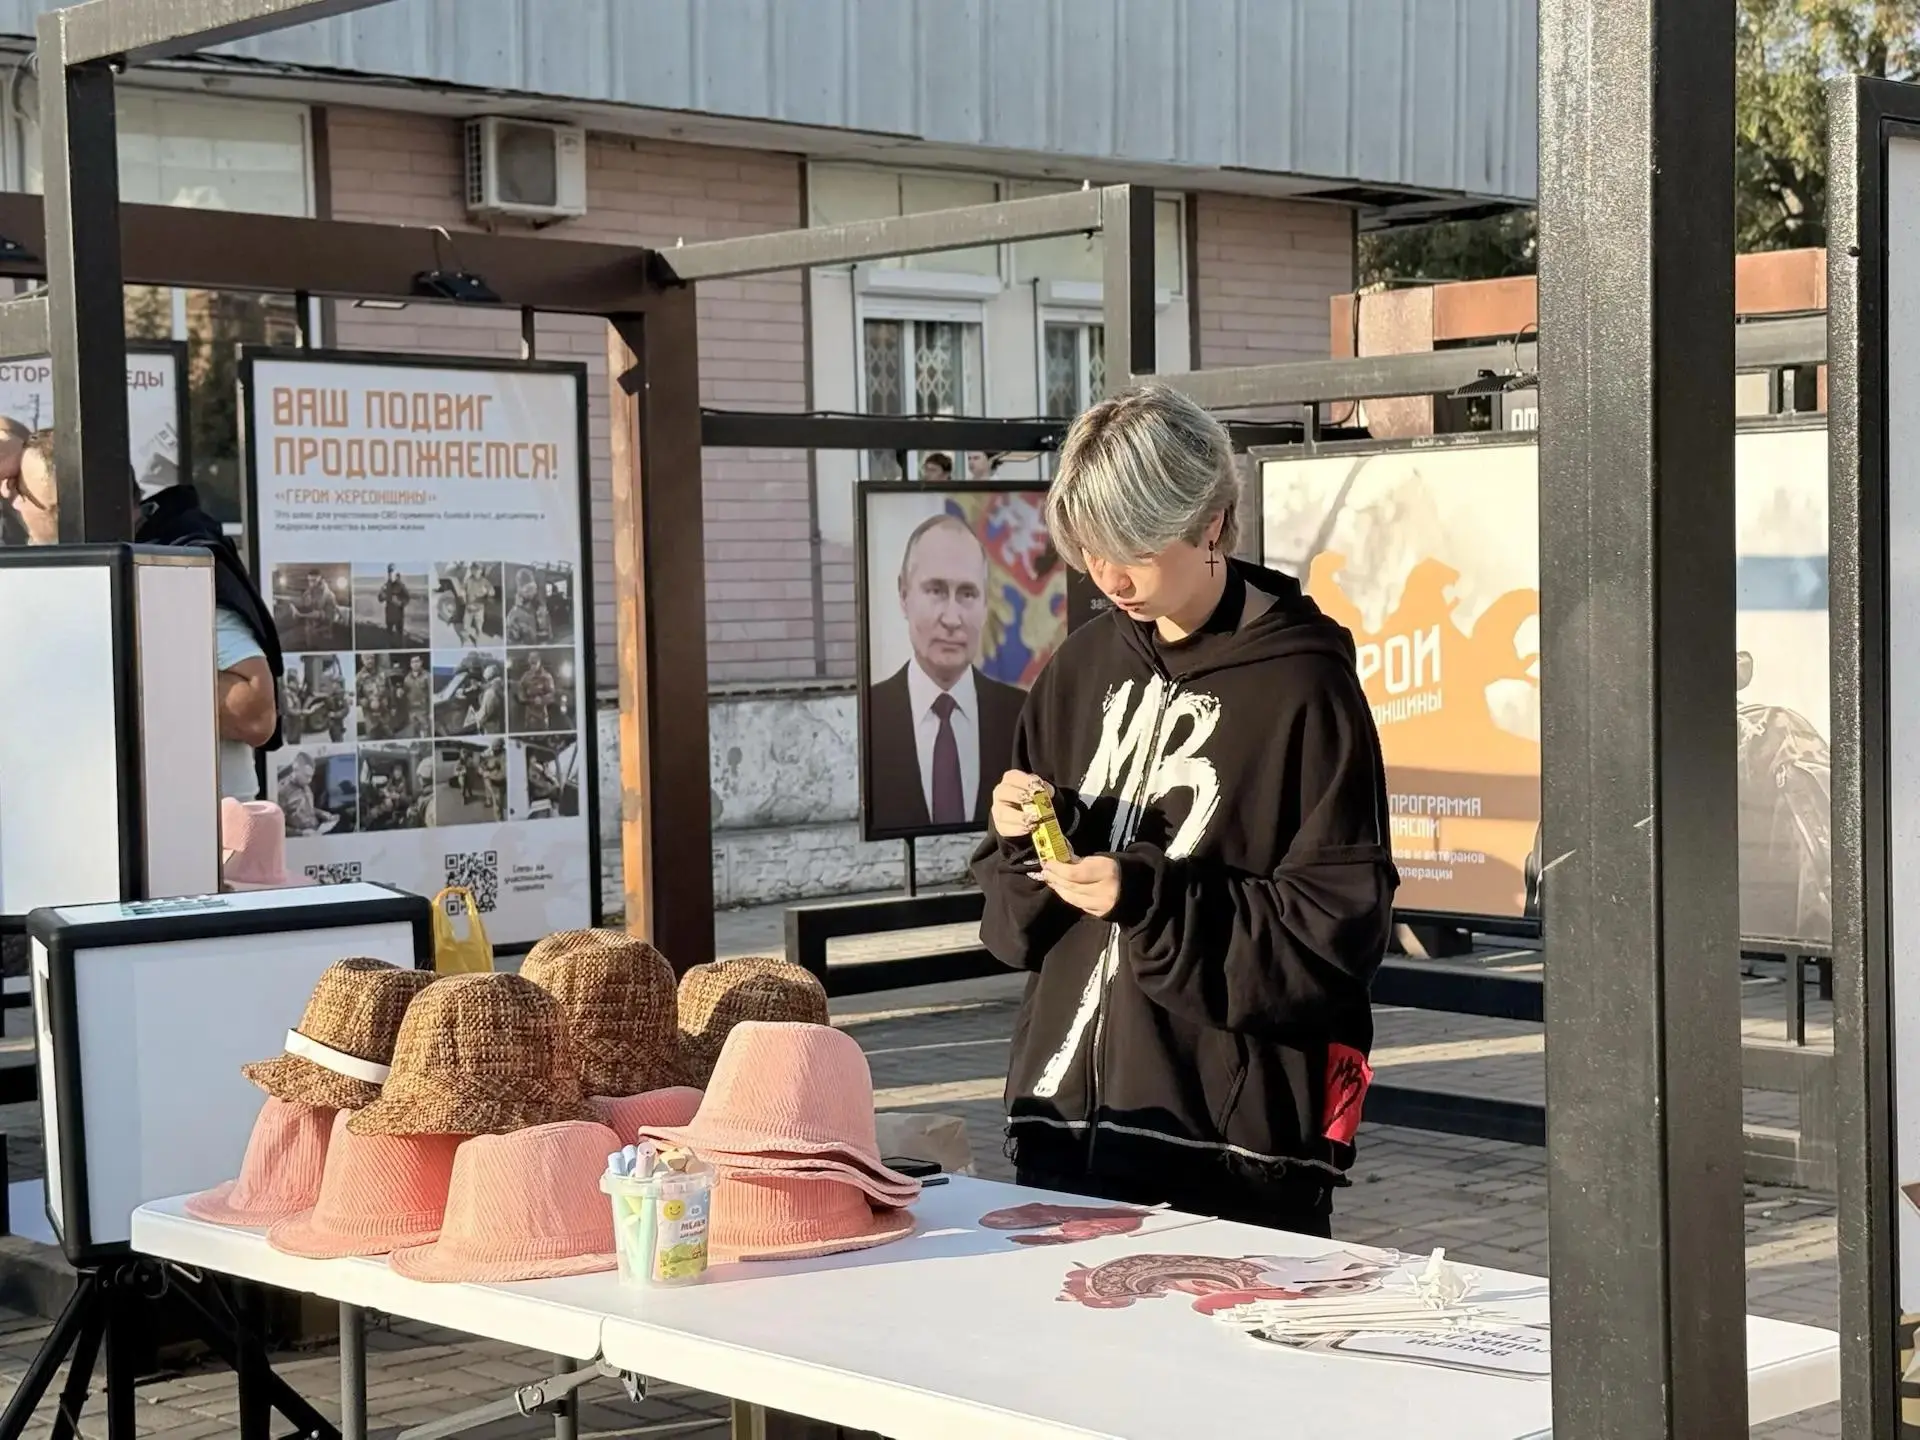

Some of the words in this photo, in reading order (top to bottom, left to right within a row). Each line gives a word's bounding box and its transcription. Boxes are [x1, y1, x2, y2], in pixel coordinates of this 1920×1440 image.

[273, 387, 348, 427] ВАШ
[366, 391, 492, 433] ПОДВИГ
[274, 437, 558, 480] ПРОДОЛЖАЕТСЯ!
[1390, 794, 1481, 817] ПРОГРАММА
